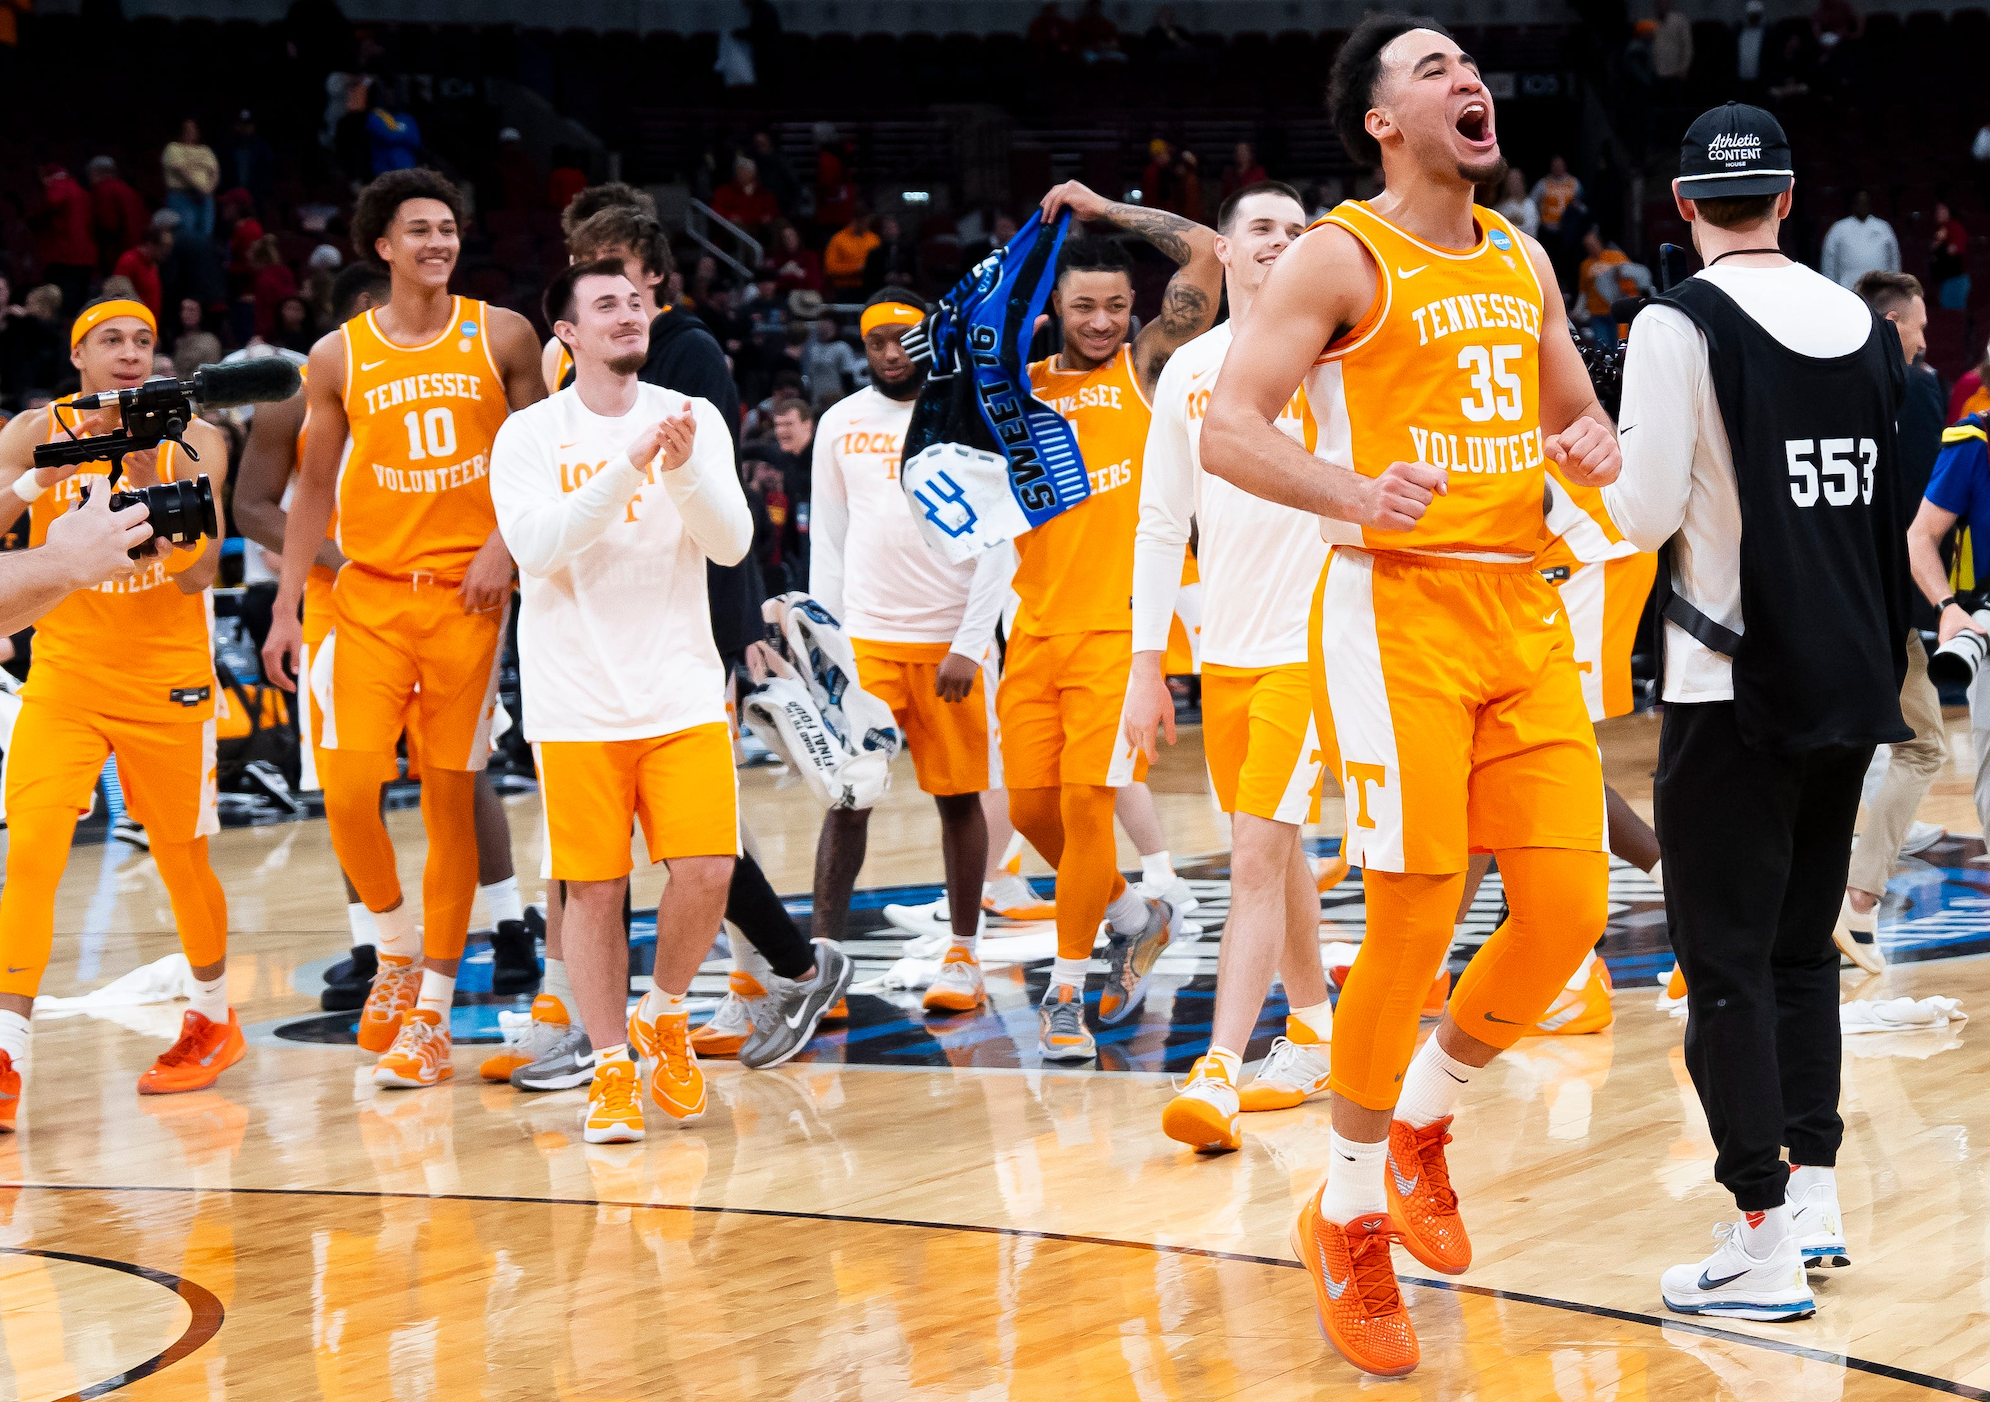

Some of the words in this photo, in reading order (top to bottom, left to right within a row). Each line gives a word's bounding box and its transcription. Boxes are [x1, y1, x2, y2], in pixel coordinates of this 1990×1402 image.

[1708, 132, 1761, 151] Athletic
[1708, 148, 1762, 161] CONTENT
[967, 323, 1000, 368] 16
[1412, 293, 1540, 346] TENNESSEE
[364, 373, 482, 415] TENNESSEE
[1457, 344, 1523, 422] 35
[403, 406, 457, 460] 10
[978, 378, 1057, 512] SWEET
[1785, 438, 1878, 507] 553
[812, 731, 834, 766] FINAL
[1346, 760, 1385, 829] T
